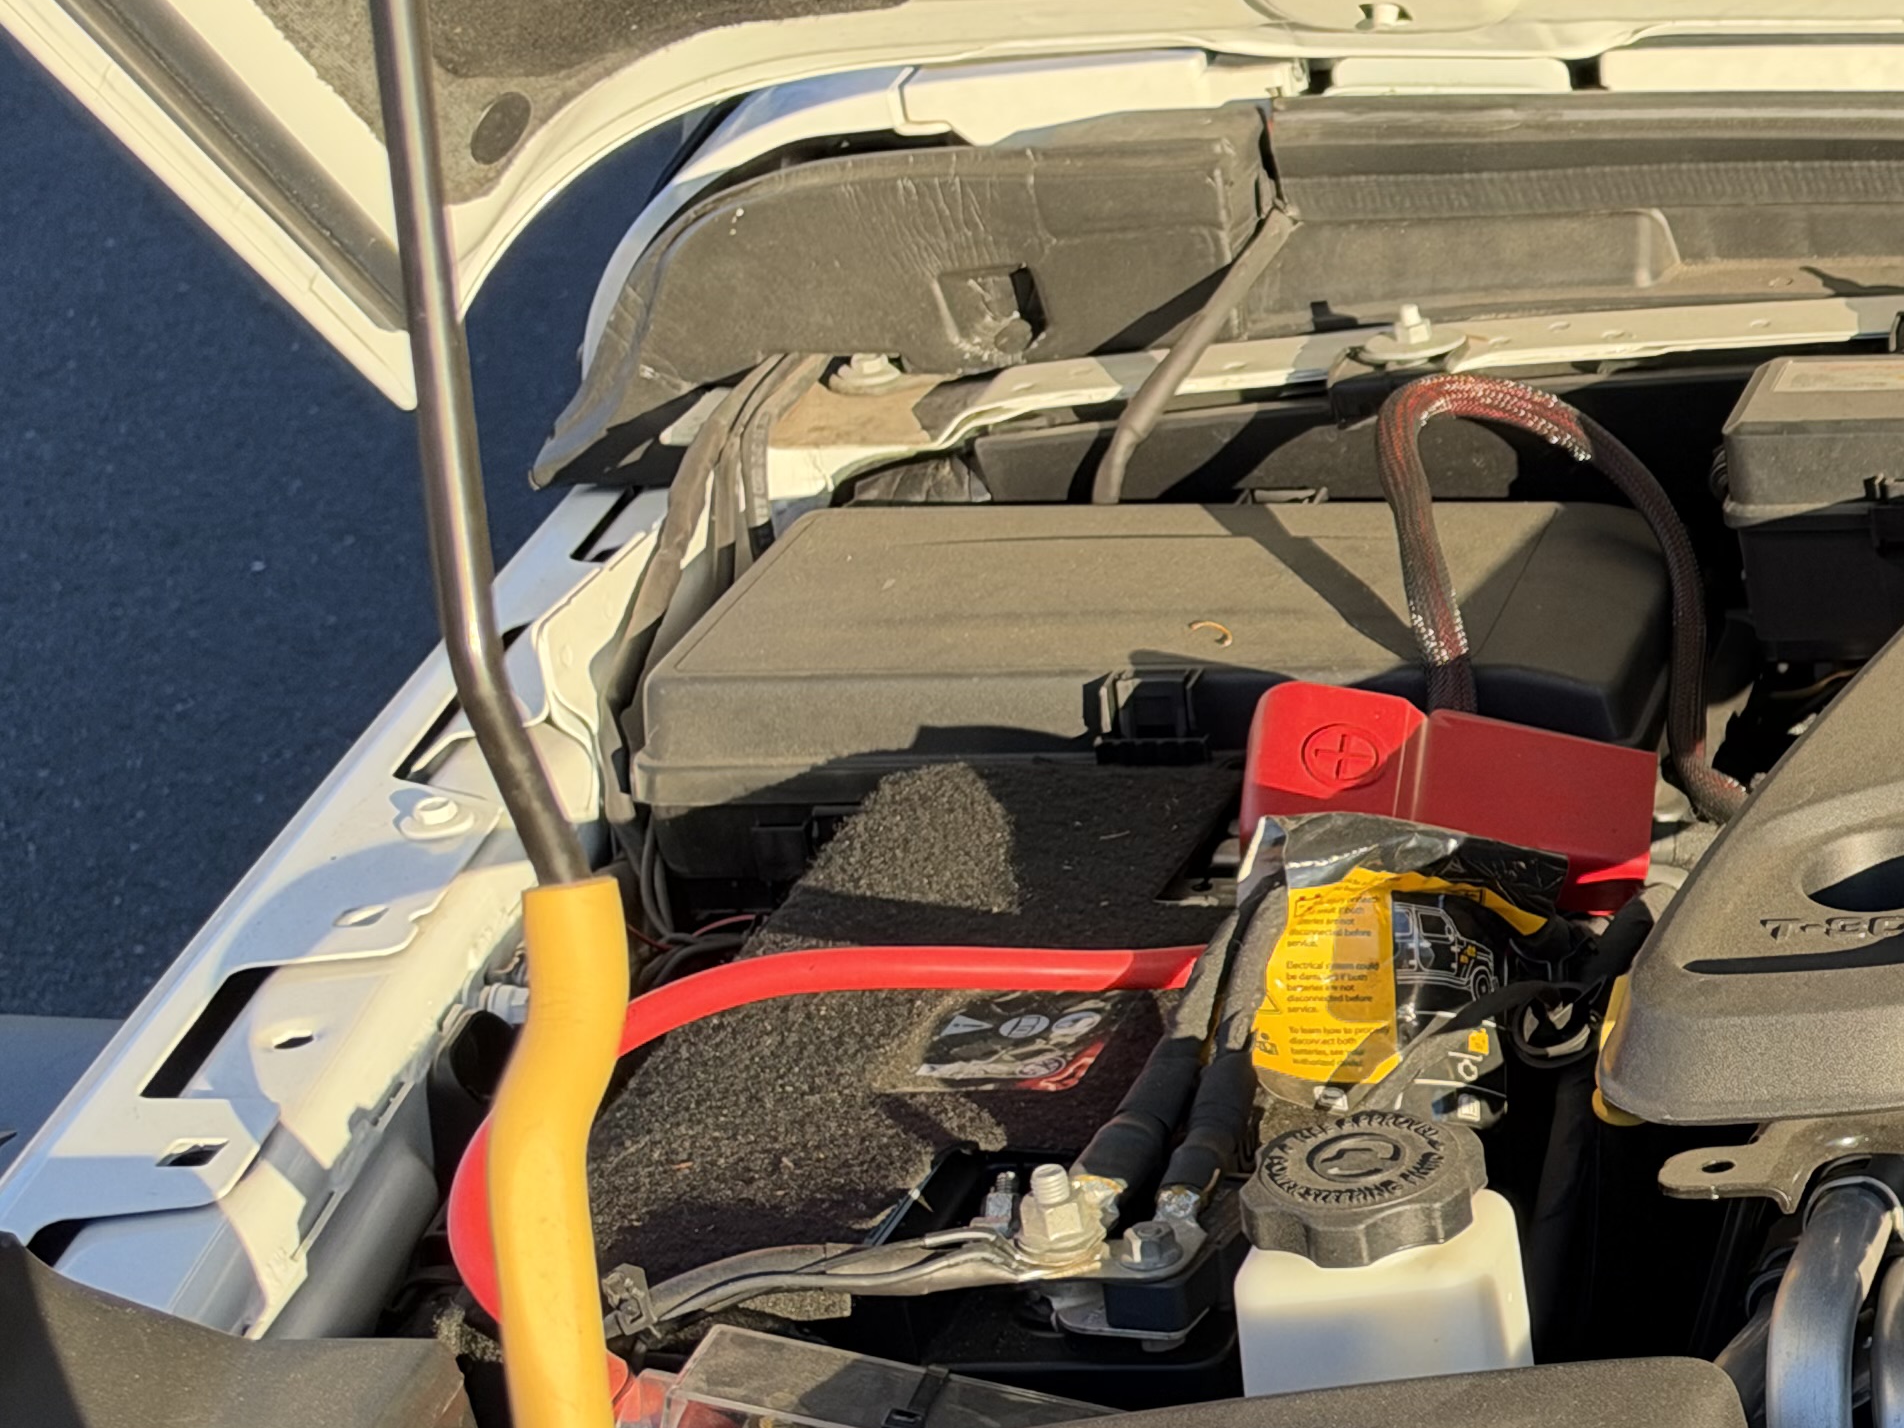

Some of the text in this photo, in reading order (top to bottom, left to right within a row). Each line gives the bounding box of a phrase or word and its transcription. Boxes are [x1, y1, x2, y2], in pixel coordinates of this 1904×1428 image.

[1286, 960, 1324, 970] Electrical
[1286, 972, 1297, 981] be
[1345, 994, 1373, 1003] before
[1288, 1025, 1299, 1035] To
[1300, 1025, 1322, 1035] learn
[1323, 1025, 1343, 1035] how
[1336, 1036, 1358, 1046] both
